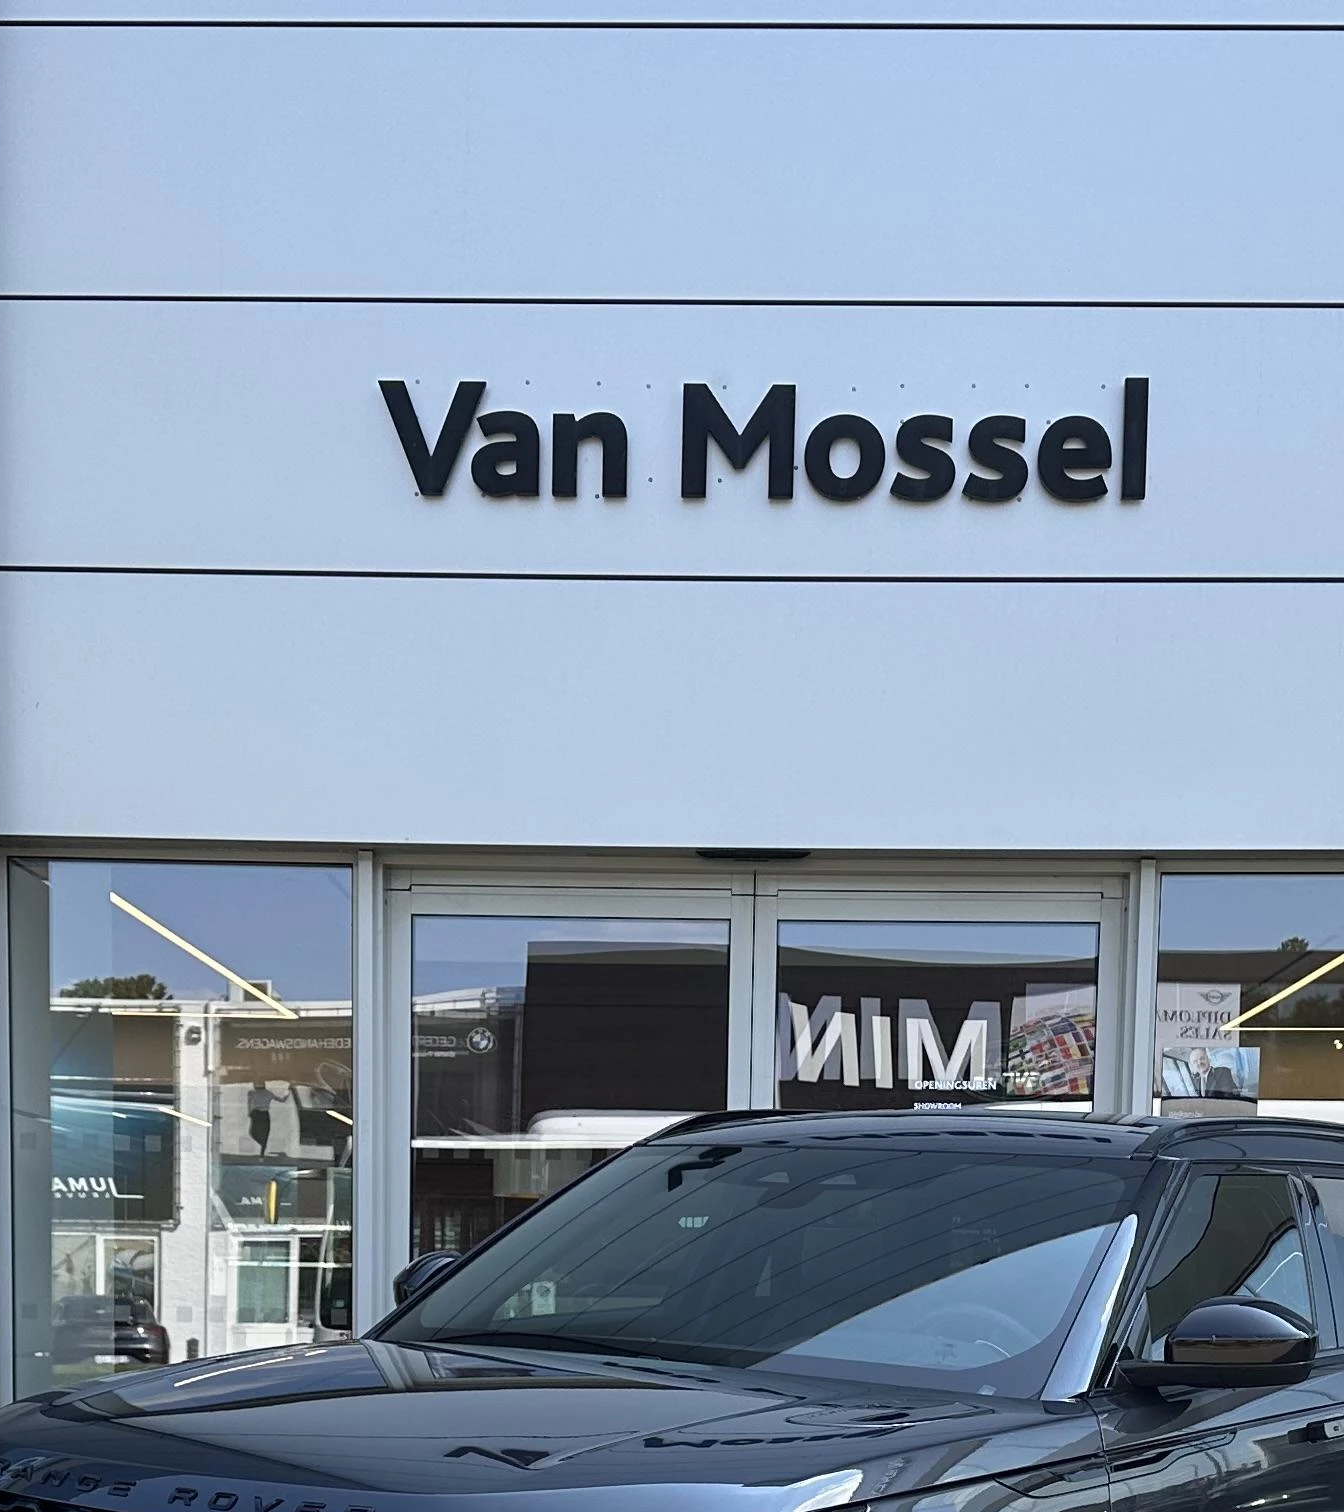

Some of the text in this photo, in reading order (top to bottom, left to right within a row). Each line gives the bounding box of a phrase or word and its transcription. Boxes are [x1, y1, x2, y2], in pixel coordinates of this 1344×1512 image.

[377, 376, 1150, 503] Van Mossel
[913, 1079, 998, 1091] OPENINGSUREN
